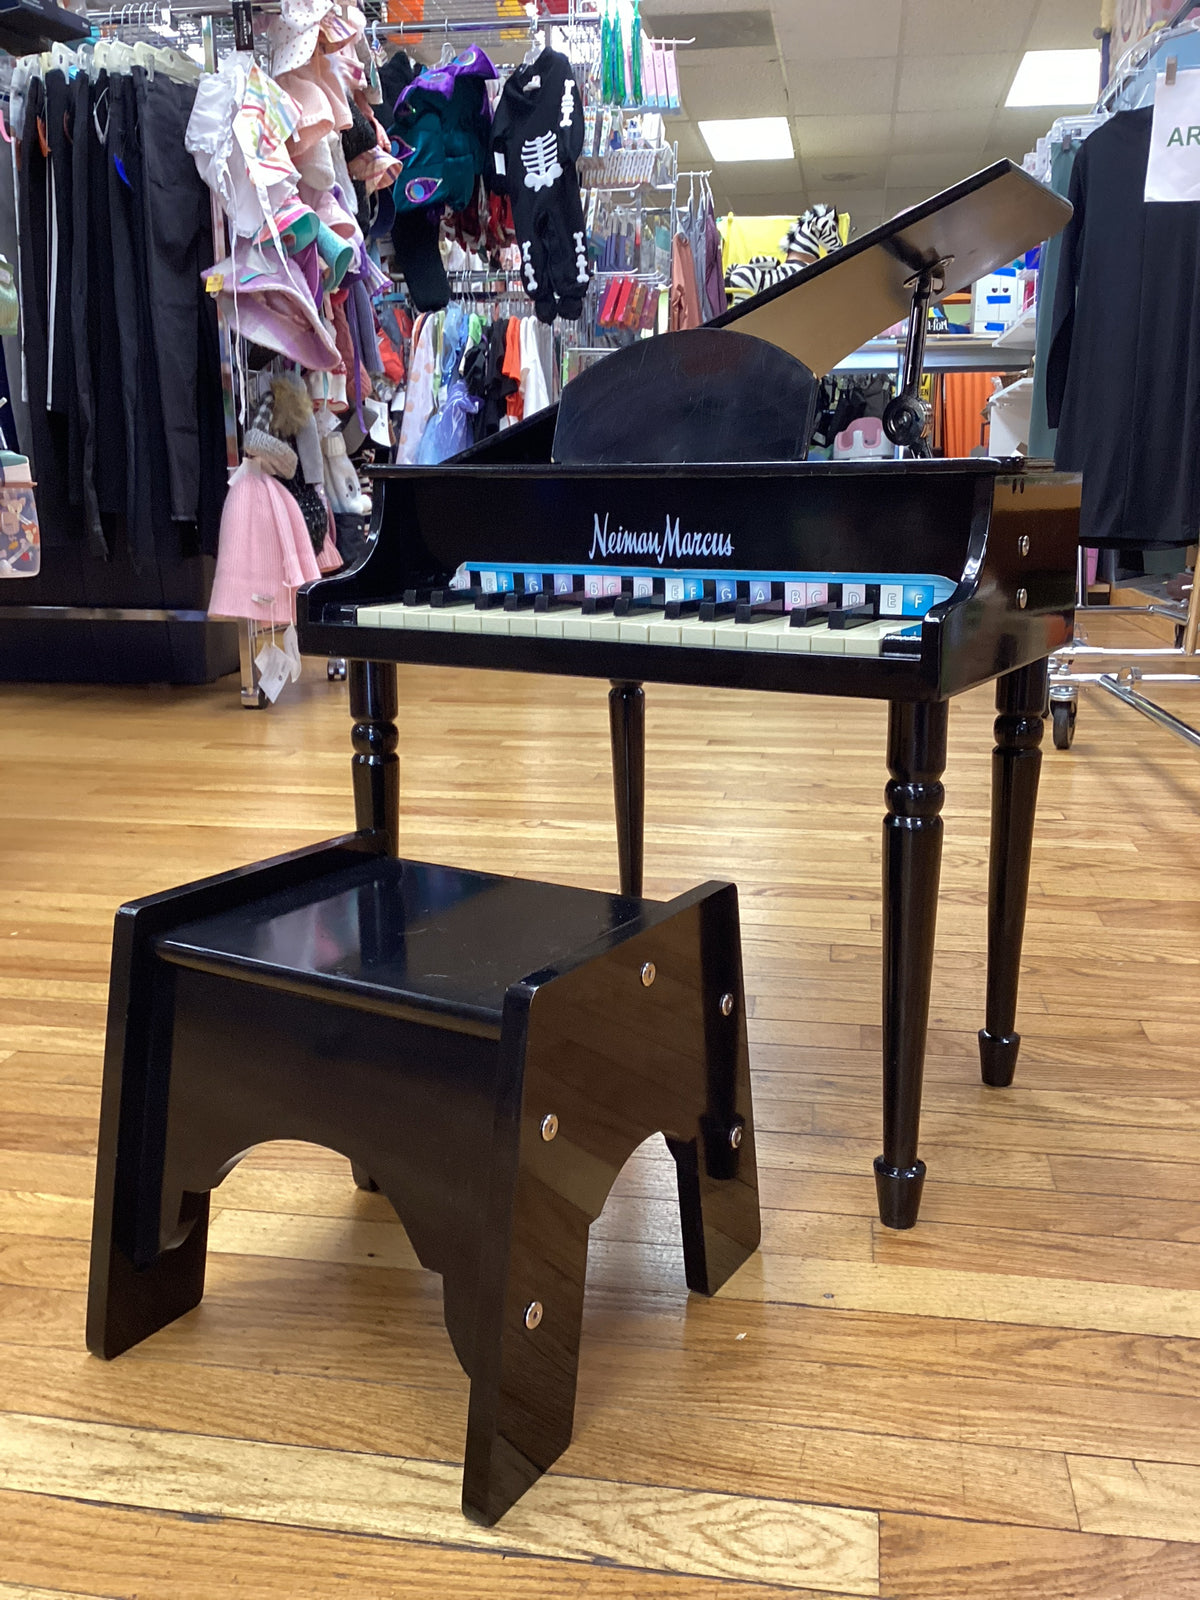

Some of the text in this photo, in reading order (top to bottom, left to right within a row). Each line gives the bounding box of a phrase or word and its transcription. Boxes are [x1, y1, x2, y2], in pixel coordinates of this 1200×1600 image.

[588, 512, 735, 564] Neiman Marcus
[486, 578, 494, 591] E
[502, 579, 509, 591] F
[529, 580, 539, 592] G
[559, 581, 568, 593] A
[590, 582, 598, 595] B
[607, 583, 616, 595] C
[638, 584, 649, 596] D
[671, 585, 680, 599] E
[690, 586, 697, 599] F
[721, 588, 732, 600] G
[755, 589, 765, 601] A
[790, 590, 801, 604] B
[811, 590, 823, 603] C
[849, 592, 861, 607] D
[887, 593, 897, 608] E
[914, 594, 924, 609] F
